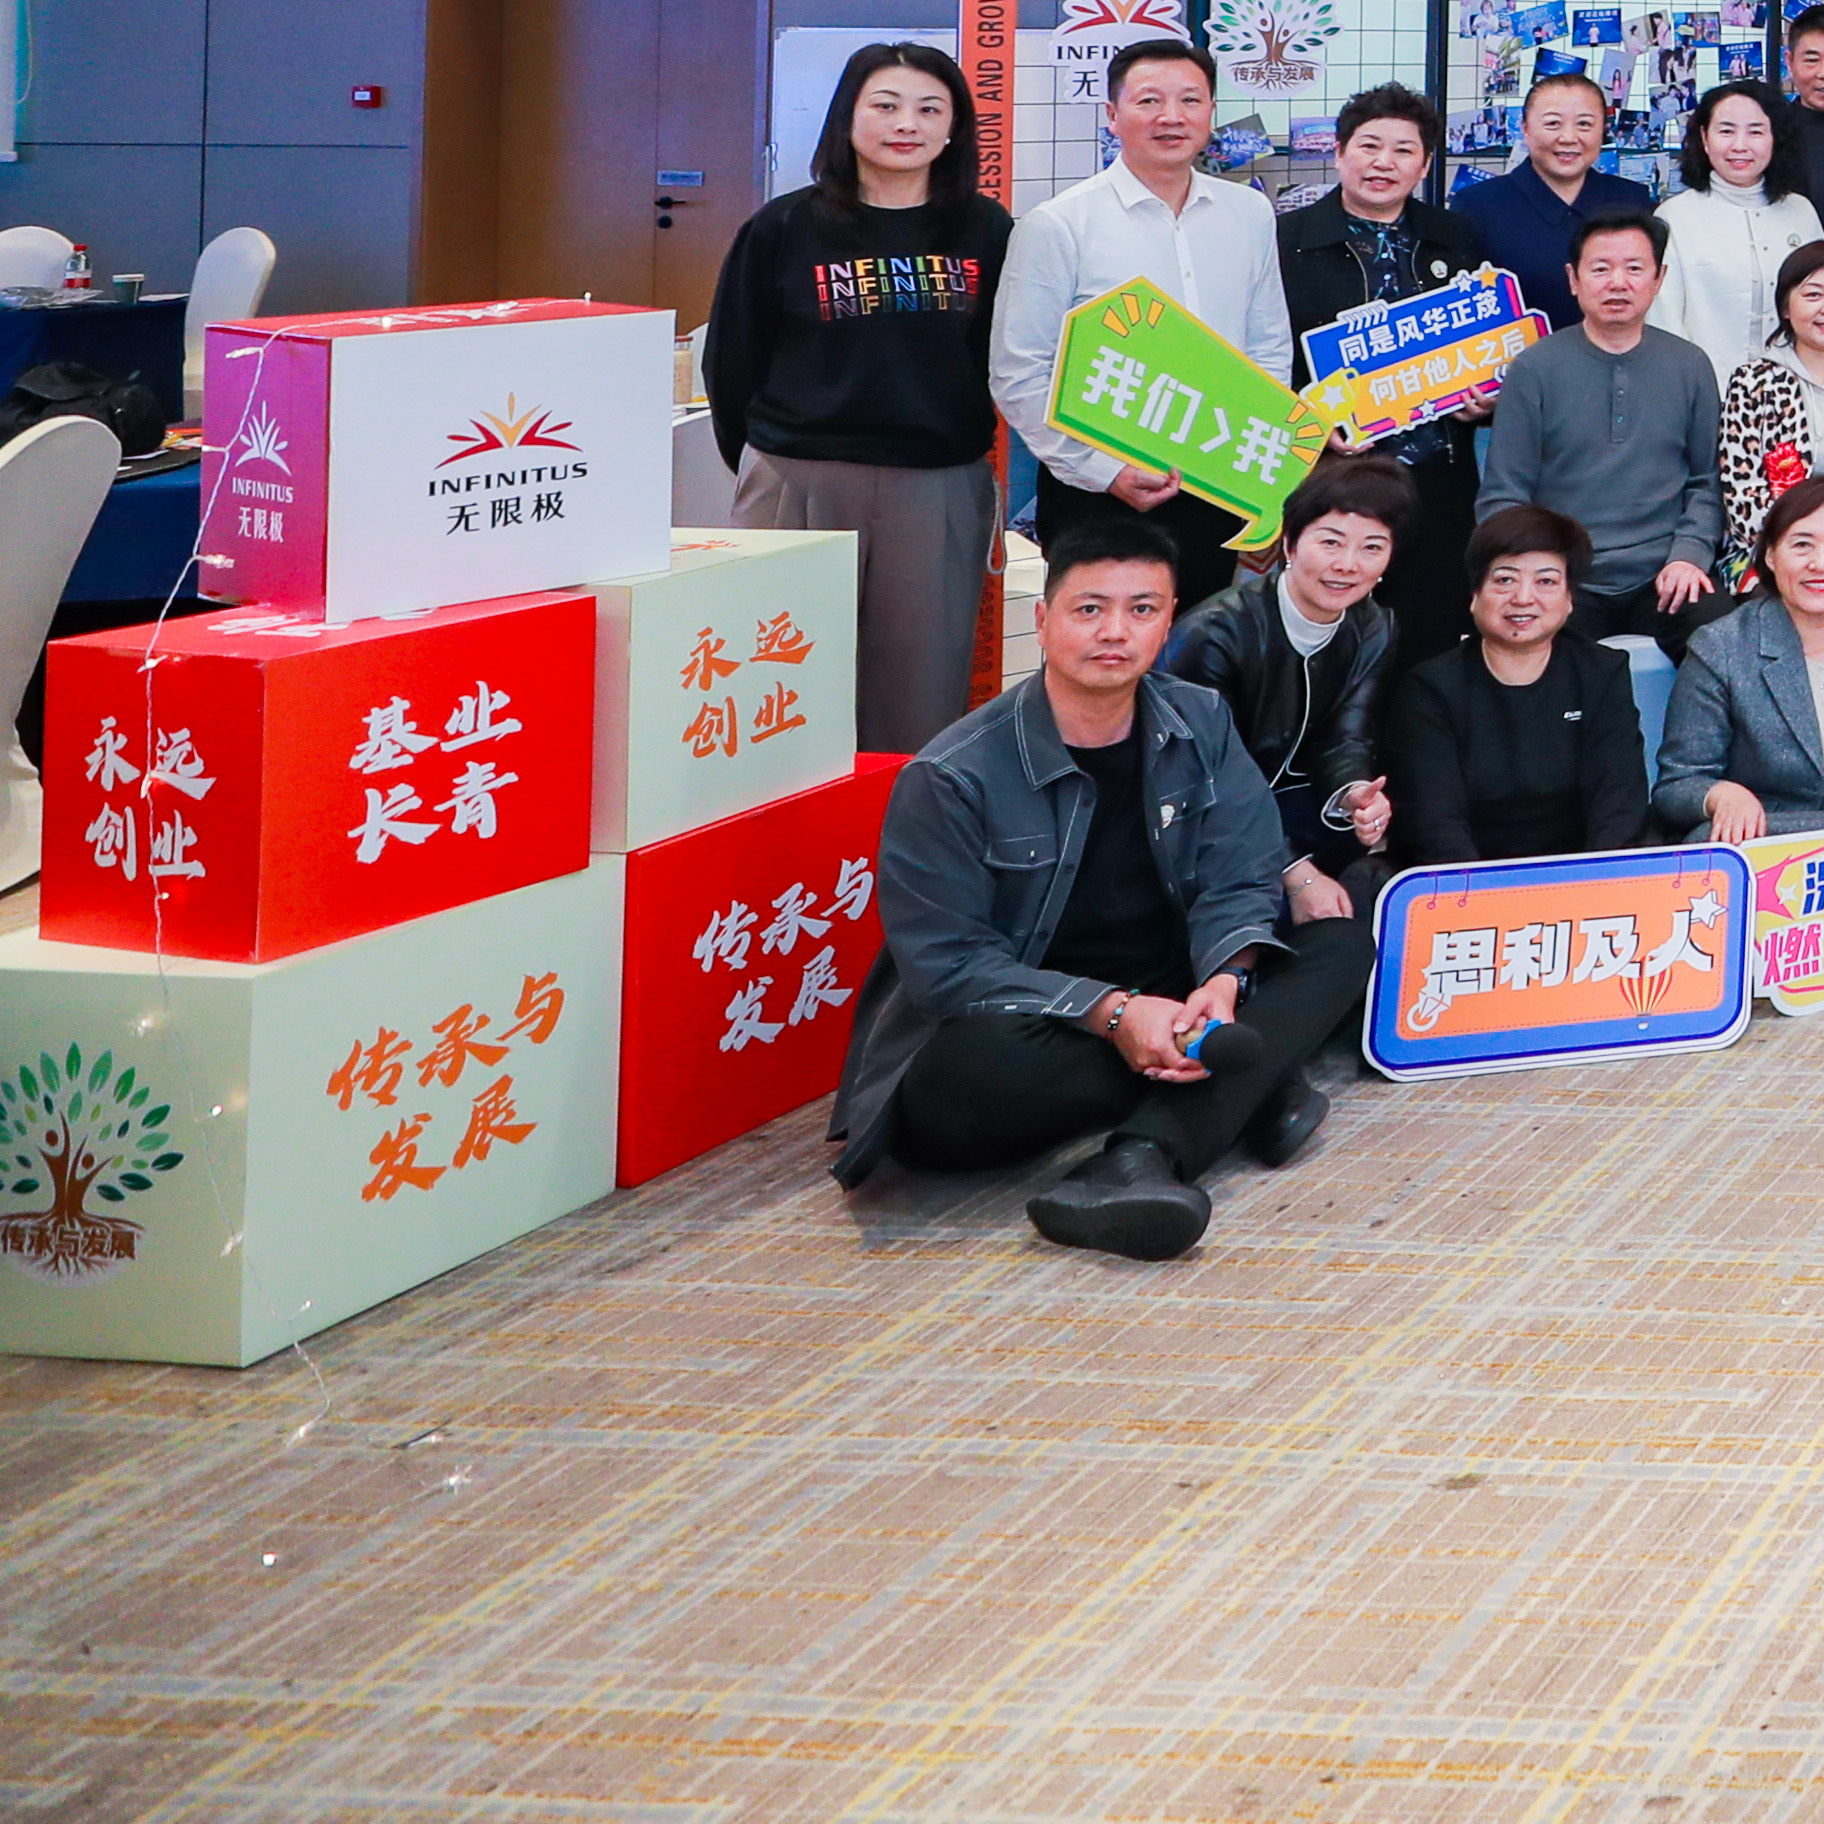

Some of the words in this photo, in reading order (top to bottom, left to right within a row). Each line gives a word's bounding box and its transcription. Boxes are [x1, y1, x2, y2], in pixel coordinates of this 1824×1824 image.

[976, 59, 1005, 102] AND
[1233, 66, 1316, 83] 传承与发展
[978, 113, 1002, 202] CESSION
[814, 255, 981, 283] INFINITUS
[817, 273, 979, 302] INFINITUS
[1338, 289, 1501, 367] 同是风华正茂
[1368, 328, 1526, 406] 何甘他人之后
[232, 477, 294, 503] INFINITUS
[427, 462, 589, 497] INFINITUS
[445, 491, 567, 536] 无限极
[237, 506, 284, 543] 无限极
[681, 610, 816, 693] 永远
[84, 716, 217, 797] 永远
[349, 679, 524, 775] 基业
[681, 681, 806, 758] 创业
[84, 802, 206, 882] 创业
[347, 761, 520, 865] 长青
[692, 856, 875, 973] 传承与
[1424, 909, 1715, 998] 思利及人
[717, 945, 855, 1053] 发展
[326, 972, 566, 1111] 传承与
[360, 1075, 539, 1202] 发展
[0, 1223, 136, 1261] 传承与发展
